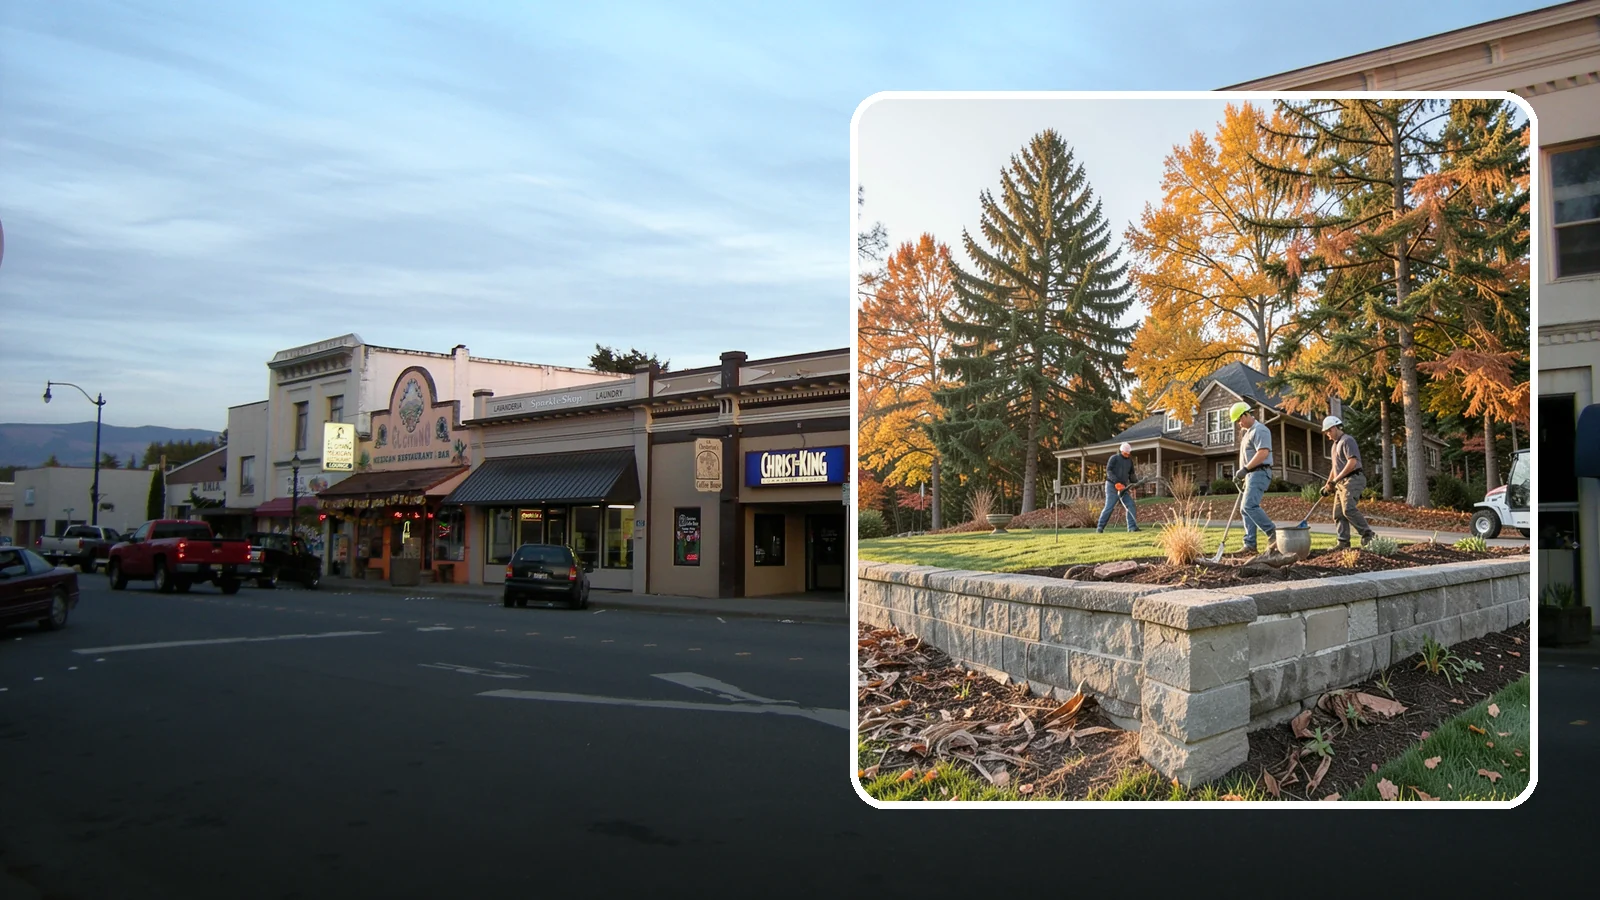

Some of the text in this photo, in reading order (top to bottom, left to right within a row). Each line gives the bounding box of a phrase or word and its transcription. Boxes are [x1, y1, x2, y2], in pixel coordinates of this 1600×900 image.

[493, 402, 522, 413] LAVANDERIA
[595, 389, 623, 400] LAUNDRY
[373, 454, 396, 464] MEXICAN
[397, 452, 433, 462] RESTAURANT
[438, 450, 450, 459] BAR
[761, 452, 797, 478] CHRIST
[799, 450, 827, 476] KING
